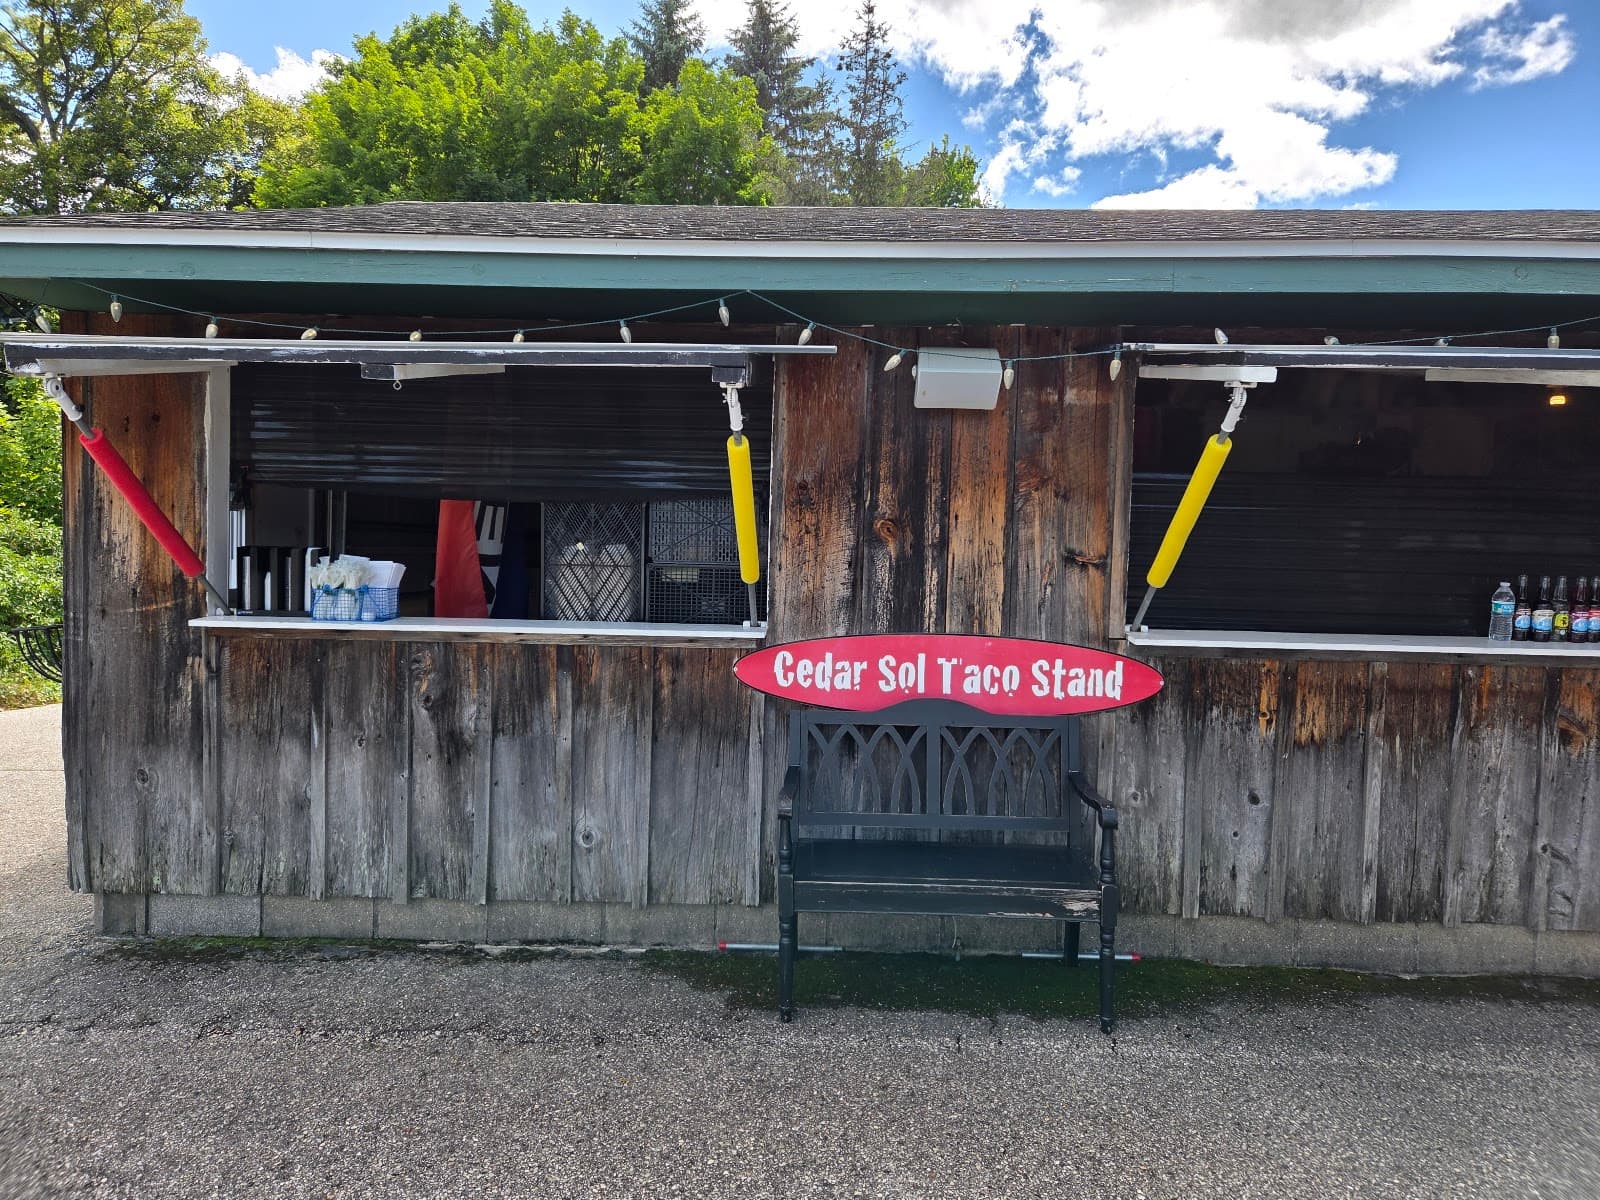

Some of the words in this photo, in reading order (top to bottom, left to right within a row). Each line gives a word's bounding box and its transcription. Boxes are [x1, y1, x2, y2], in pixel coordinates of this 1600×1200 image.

[773, 650, 868, 692] Cedar
[878, 653, 926, 694] Sol
[1031, 659, 1124, 701] Stand
